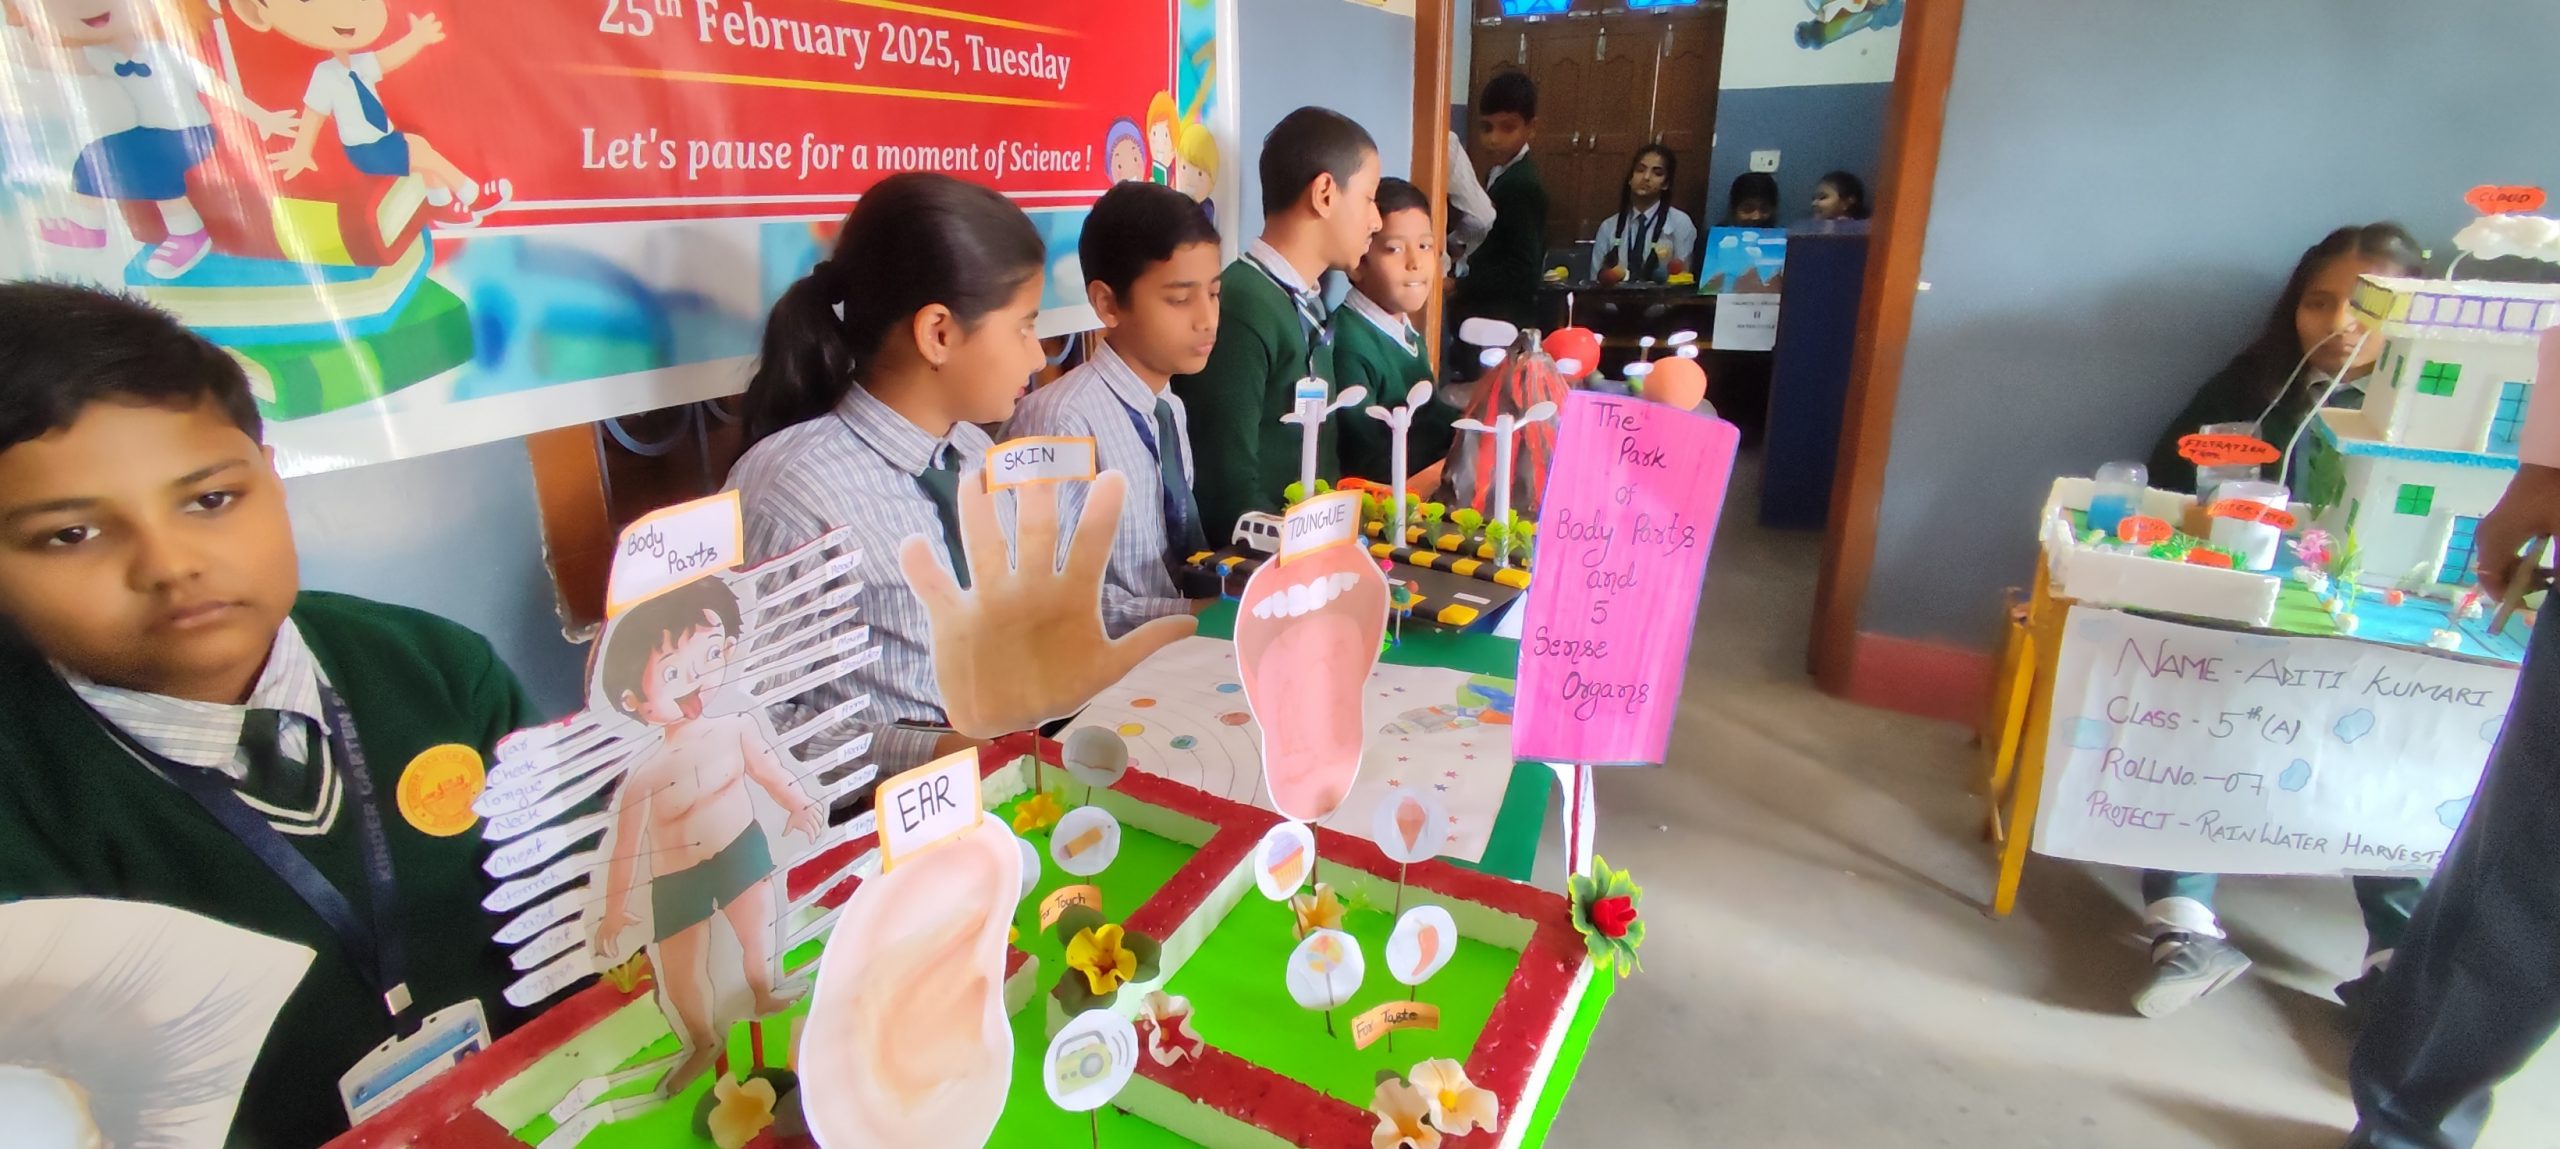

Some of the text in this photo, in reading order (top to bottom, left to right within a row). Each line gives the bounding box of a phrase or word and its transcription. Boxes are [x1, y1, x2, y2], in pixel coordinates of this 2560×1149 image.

[696, 0, 871, 70] February
[878, 22, 960, 75] 2025,
[965, 33, 1071, 90] Tuesday
[581, 128, 677, 170] Let's
[688, 139, 793, 180] pause
[798, 132, 845, 180] for
[851, 144, 868, 170] a
[876, 143, 979, 171] moment
[984, 140, 1007, 179] of
[1010, 141, 1081, 172] Science
[1590, 401, 1643, 432] The
[1004, 446, 1055, 471] SKIN
[1617, 435, 1667, 469] Park
[627, 523, 665, 558] Body
[1556, 507, 1697, 568] Body Parts
[667, 541, 718, 574] Parts
[1585, 561, 1638, 595] and
[1590, 600, 1610, 625] 5
[1533, 625, 1610, 666] Sense
[2113, 638, 2223, 682] NAME
[2244, 658, 2347, 689] ADITI
[2361, 665, 2493, 708] KUMARI
[1562, 670, 1650, 722] Organs
[2106, 695, 2181, 730] CLASS
[490, 760, 538, 785] Cheek
[481, 779, 542, 810] Tongue
[897, 775, 956, 833] EAR
[494, 809, 540, 835] Neck
[2086, 790, 2176, 830] PROJECT
[2341, 832, 2444, 864] HARVEST
[1055, 892, 1086, 909] Touch
[1356, 1008, 1418, 1039] For Taste
